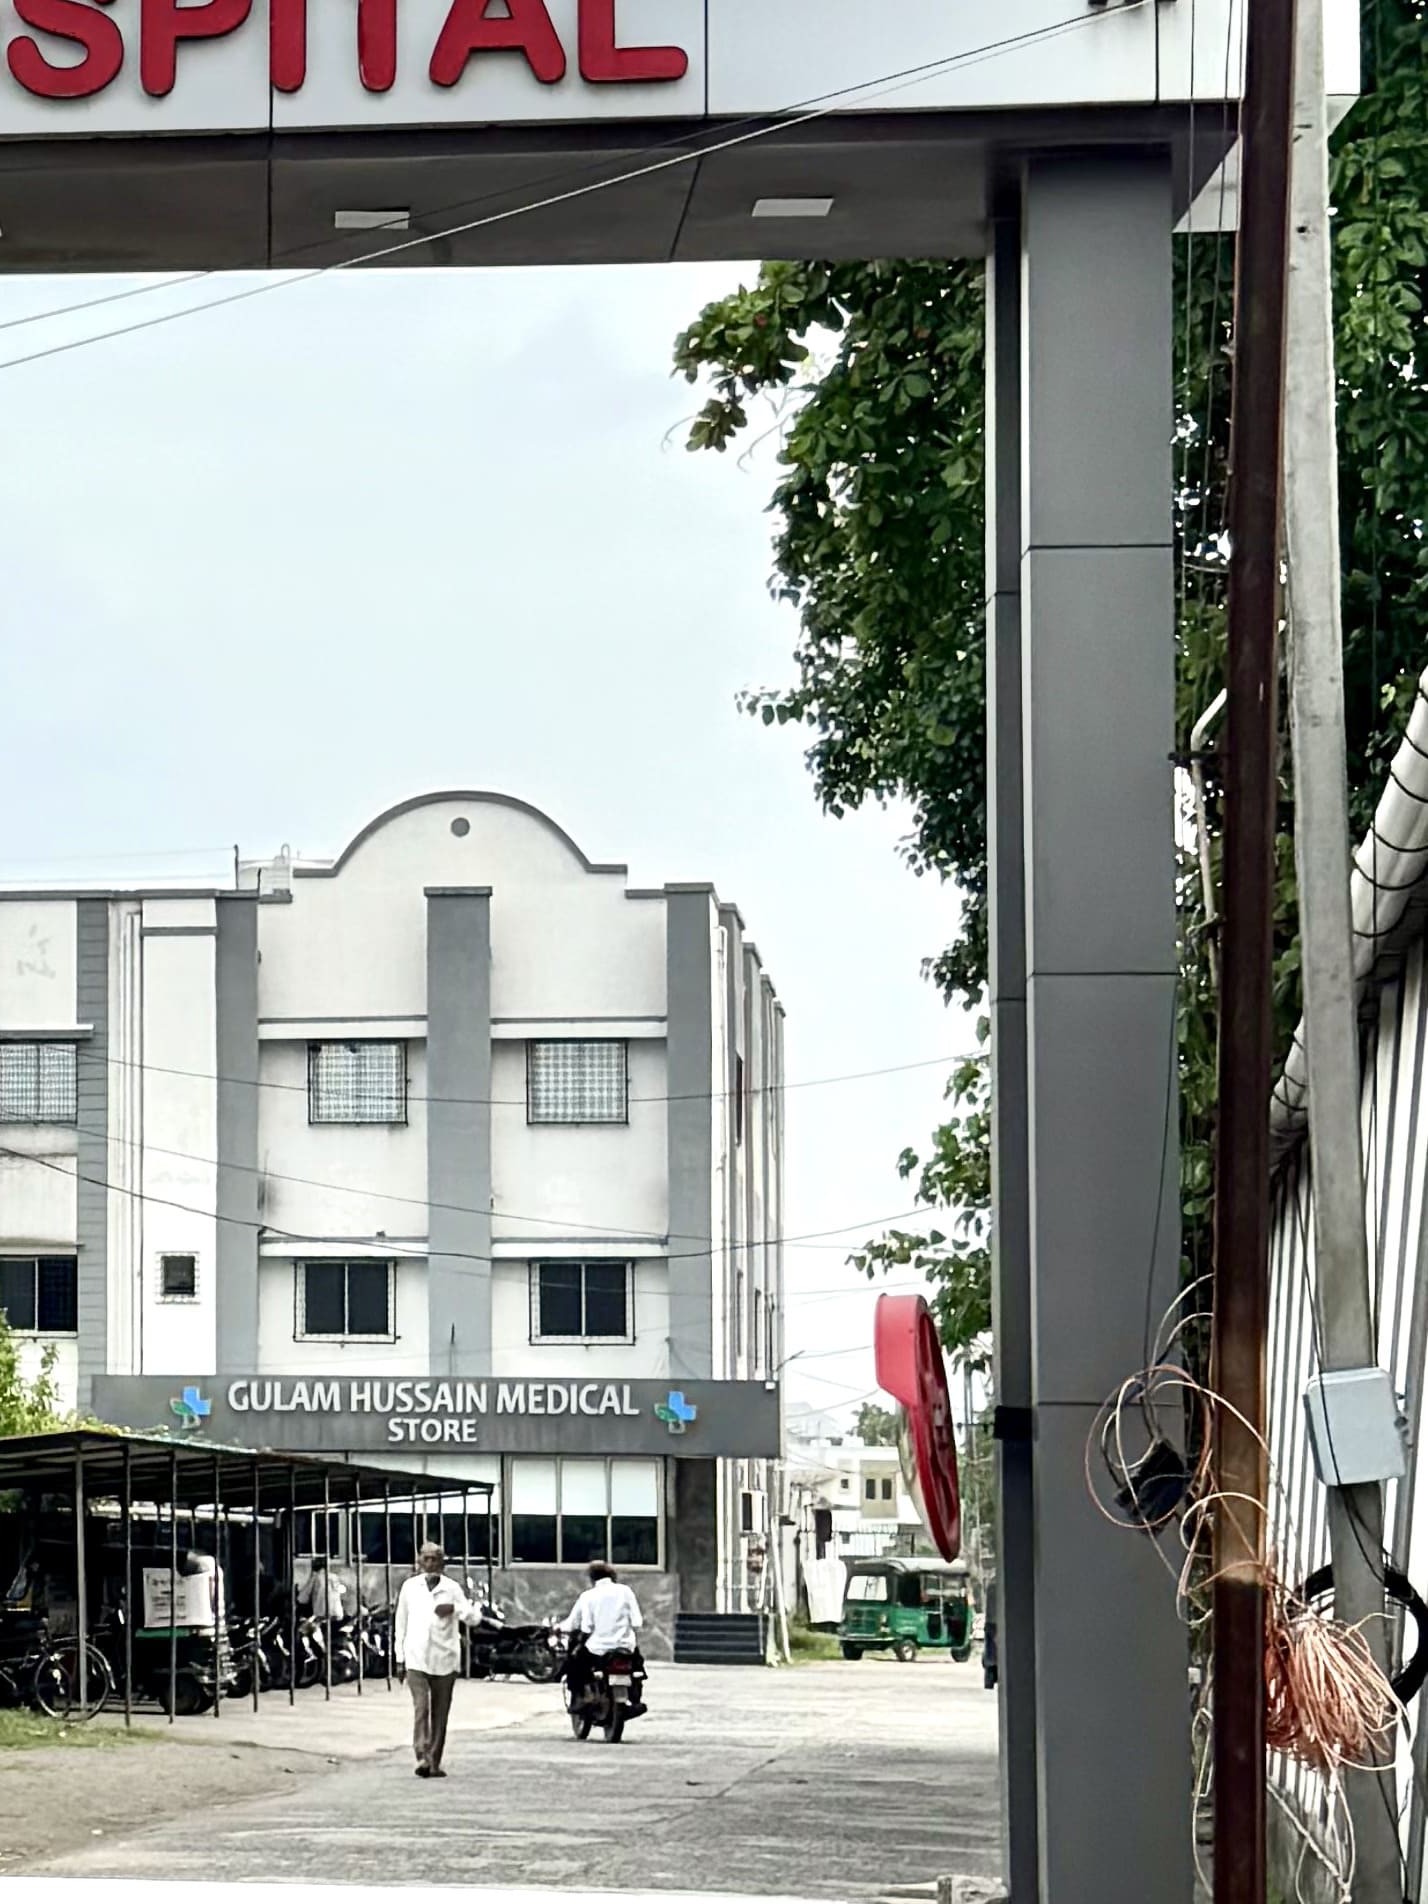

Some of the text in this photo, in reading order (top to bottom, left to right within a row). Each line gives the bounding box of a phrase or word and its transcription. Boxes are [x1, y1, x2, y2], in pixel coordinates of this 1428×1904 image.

[228, 1379, 640, 1416] GULAM HUSSAIN MEDICAL
[388, 1417, 478, 1443] STORE
